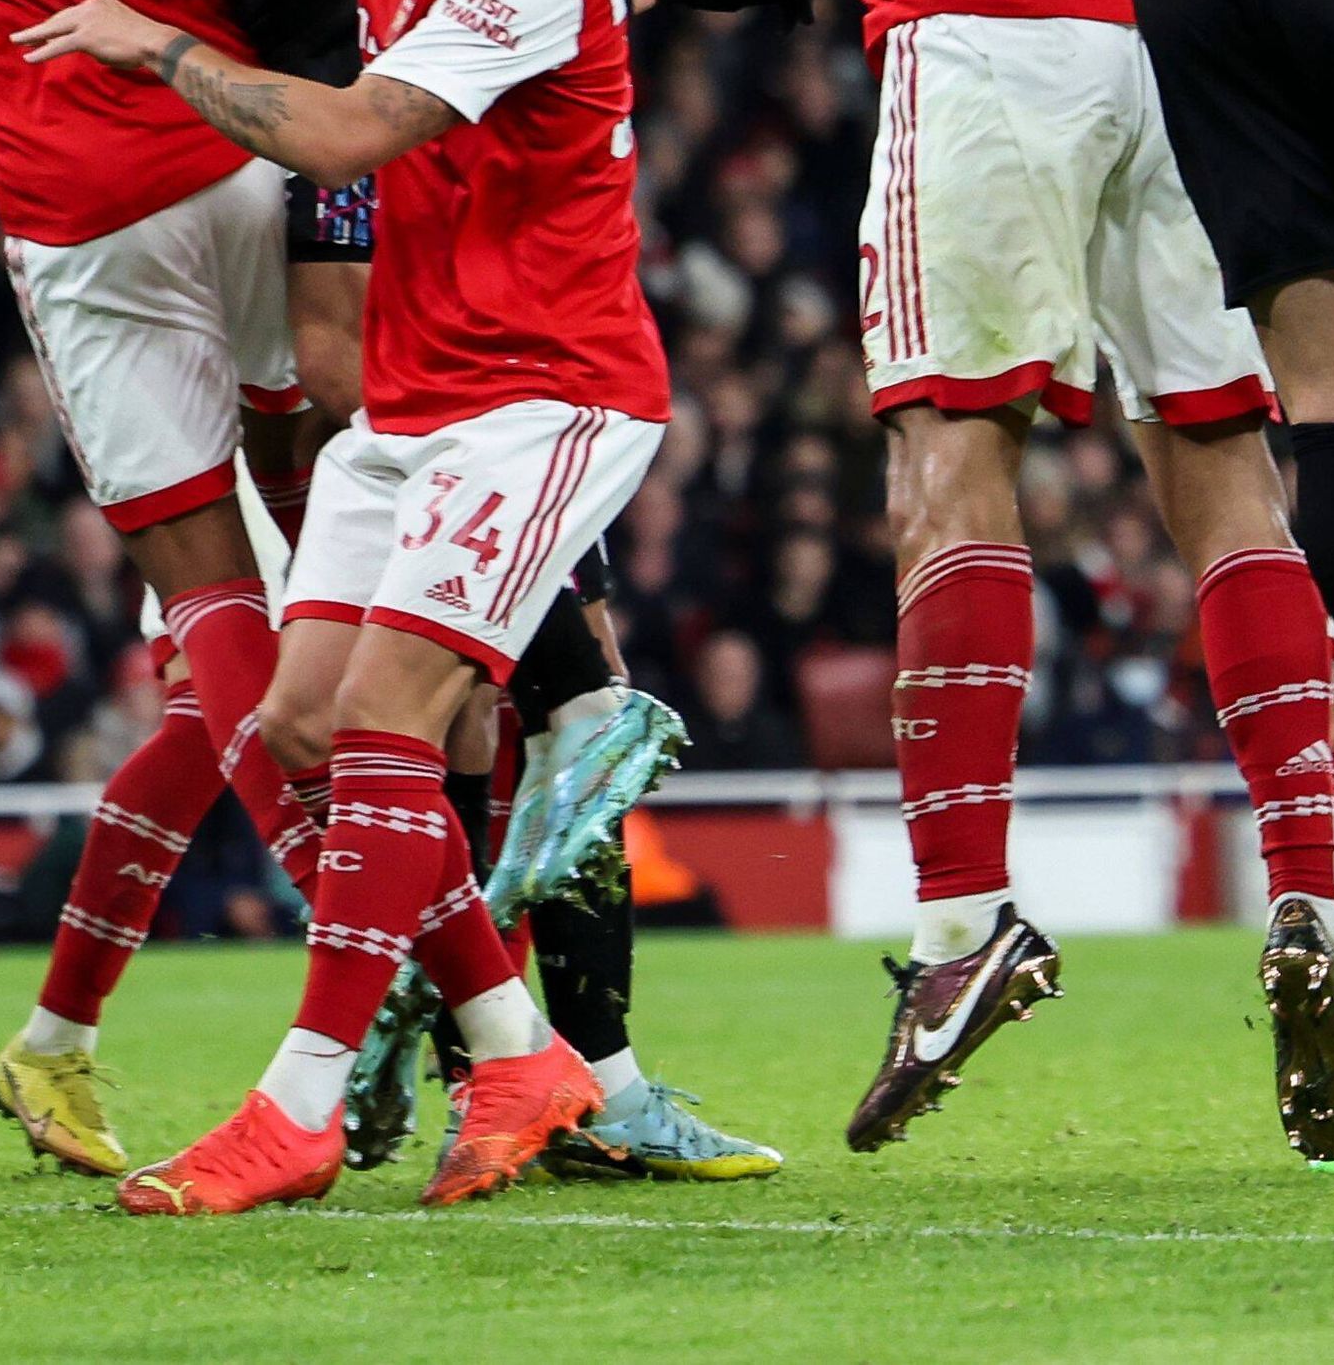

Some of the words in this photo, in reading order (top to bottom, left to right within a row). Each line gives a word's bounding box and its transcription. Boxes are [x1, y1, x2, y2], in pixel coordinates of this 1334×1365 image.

[401, 471, 508, 575] 34
[890, 714, 938, 741] FC
[316, 850, 362, 873] FC
